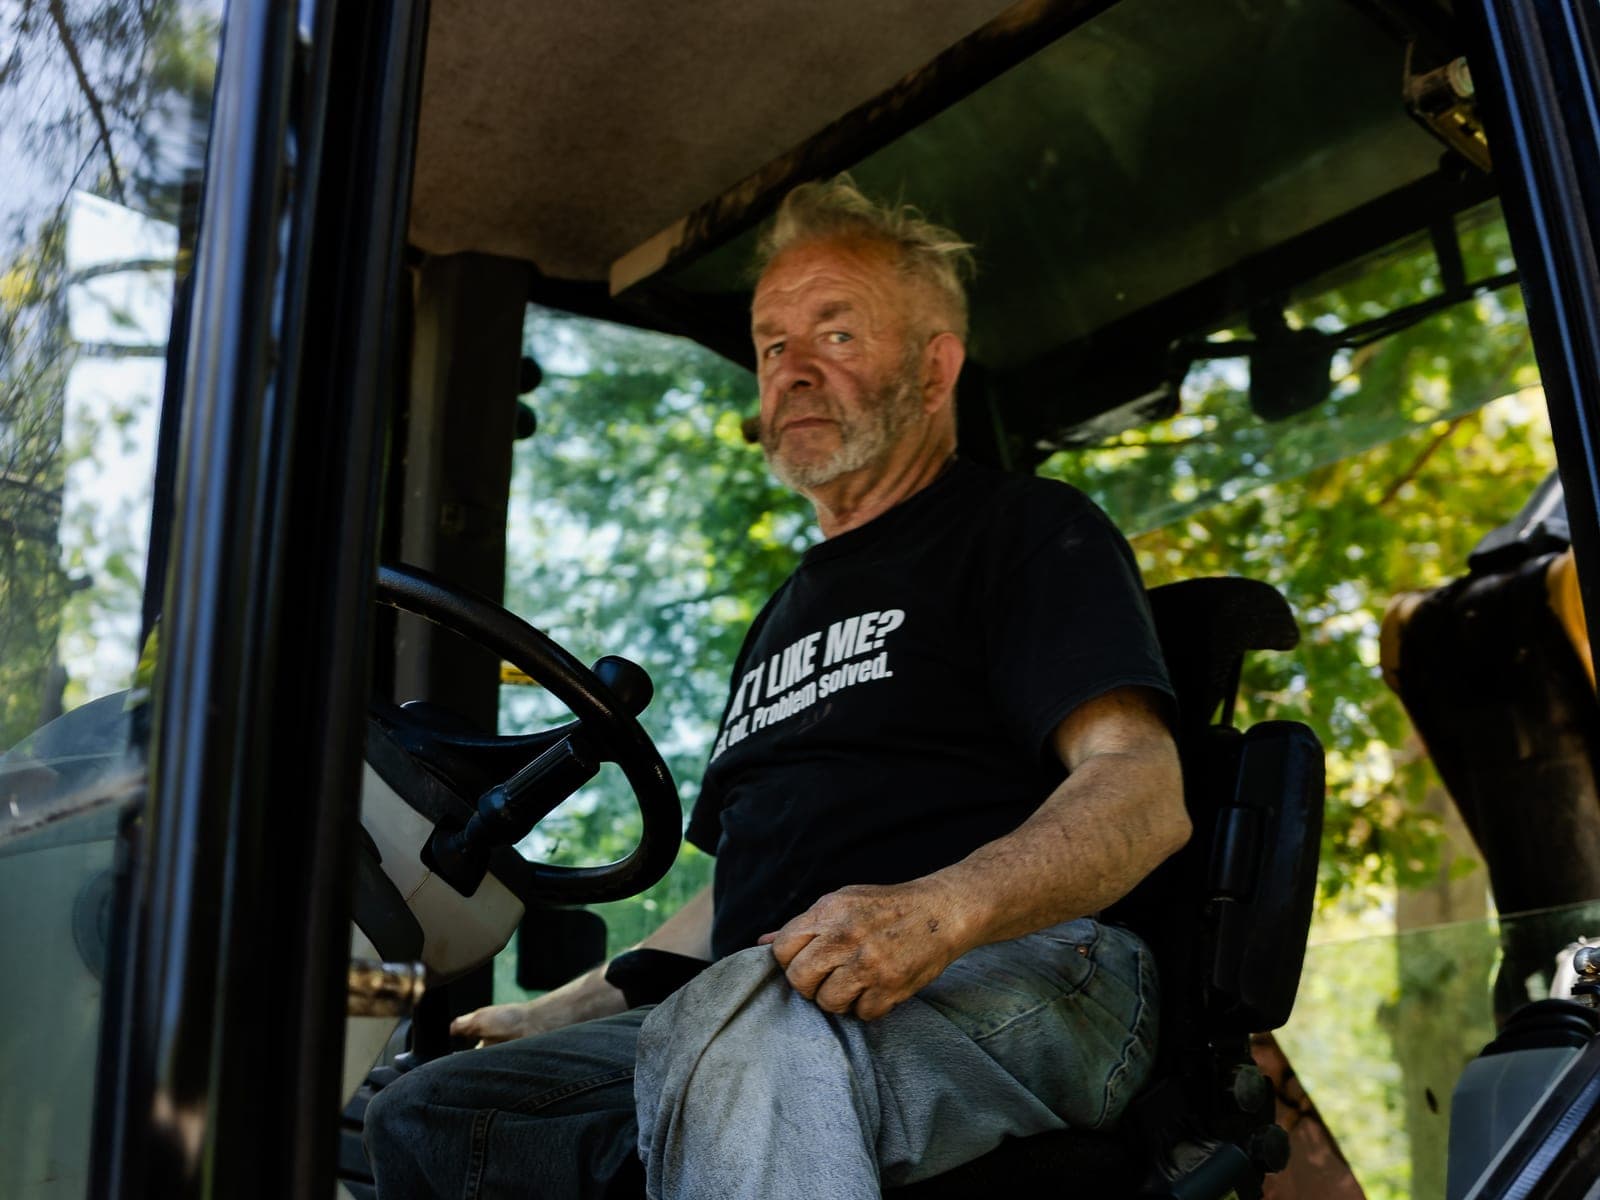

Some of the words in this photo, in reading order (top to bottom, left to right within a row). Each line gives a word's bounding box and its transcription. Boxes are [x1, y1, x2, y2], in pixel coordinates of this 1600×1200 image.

[751, 681, 817, 733] Problem
[818, 651, 894, 698] solved.
[766, 631, 822, 698] LIKE
[822, 609, 905, 668] ME?
